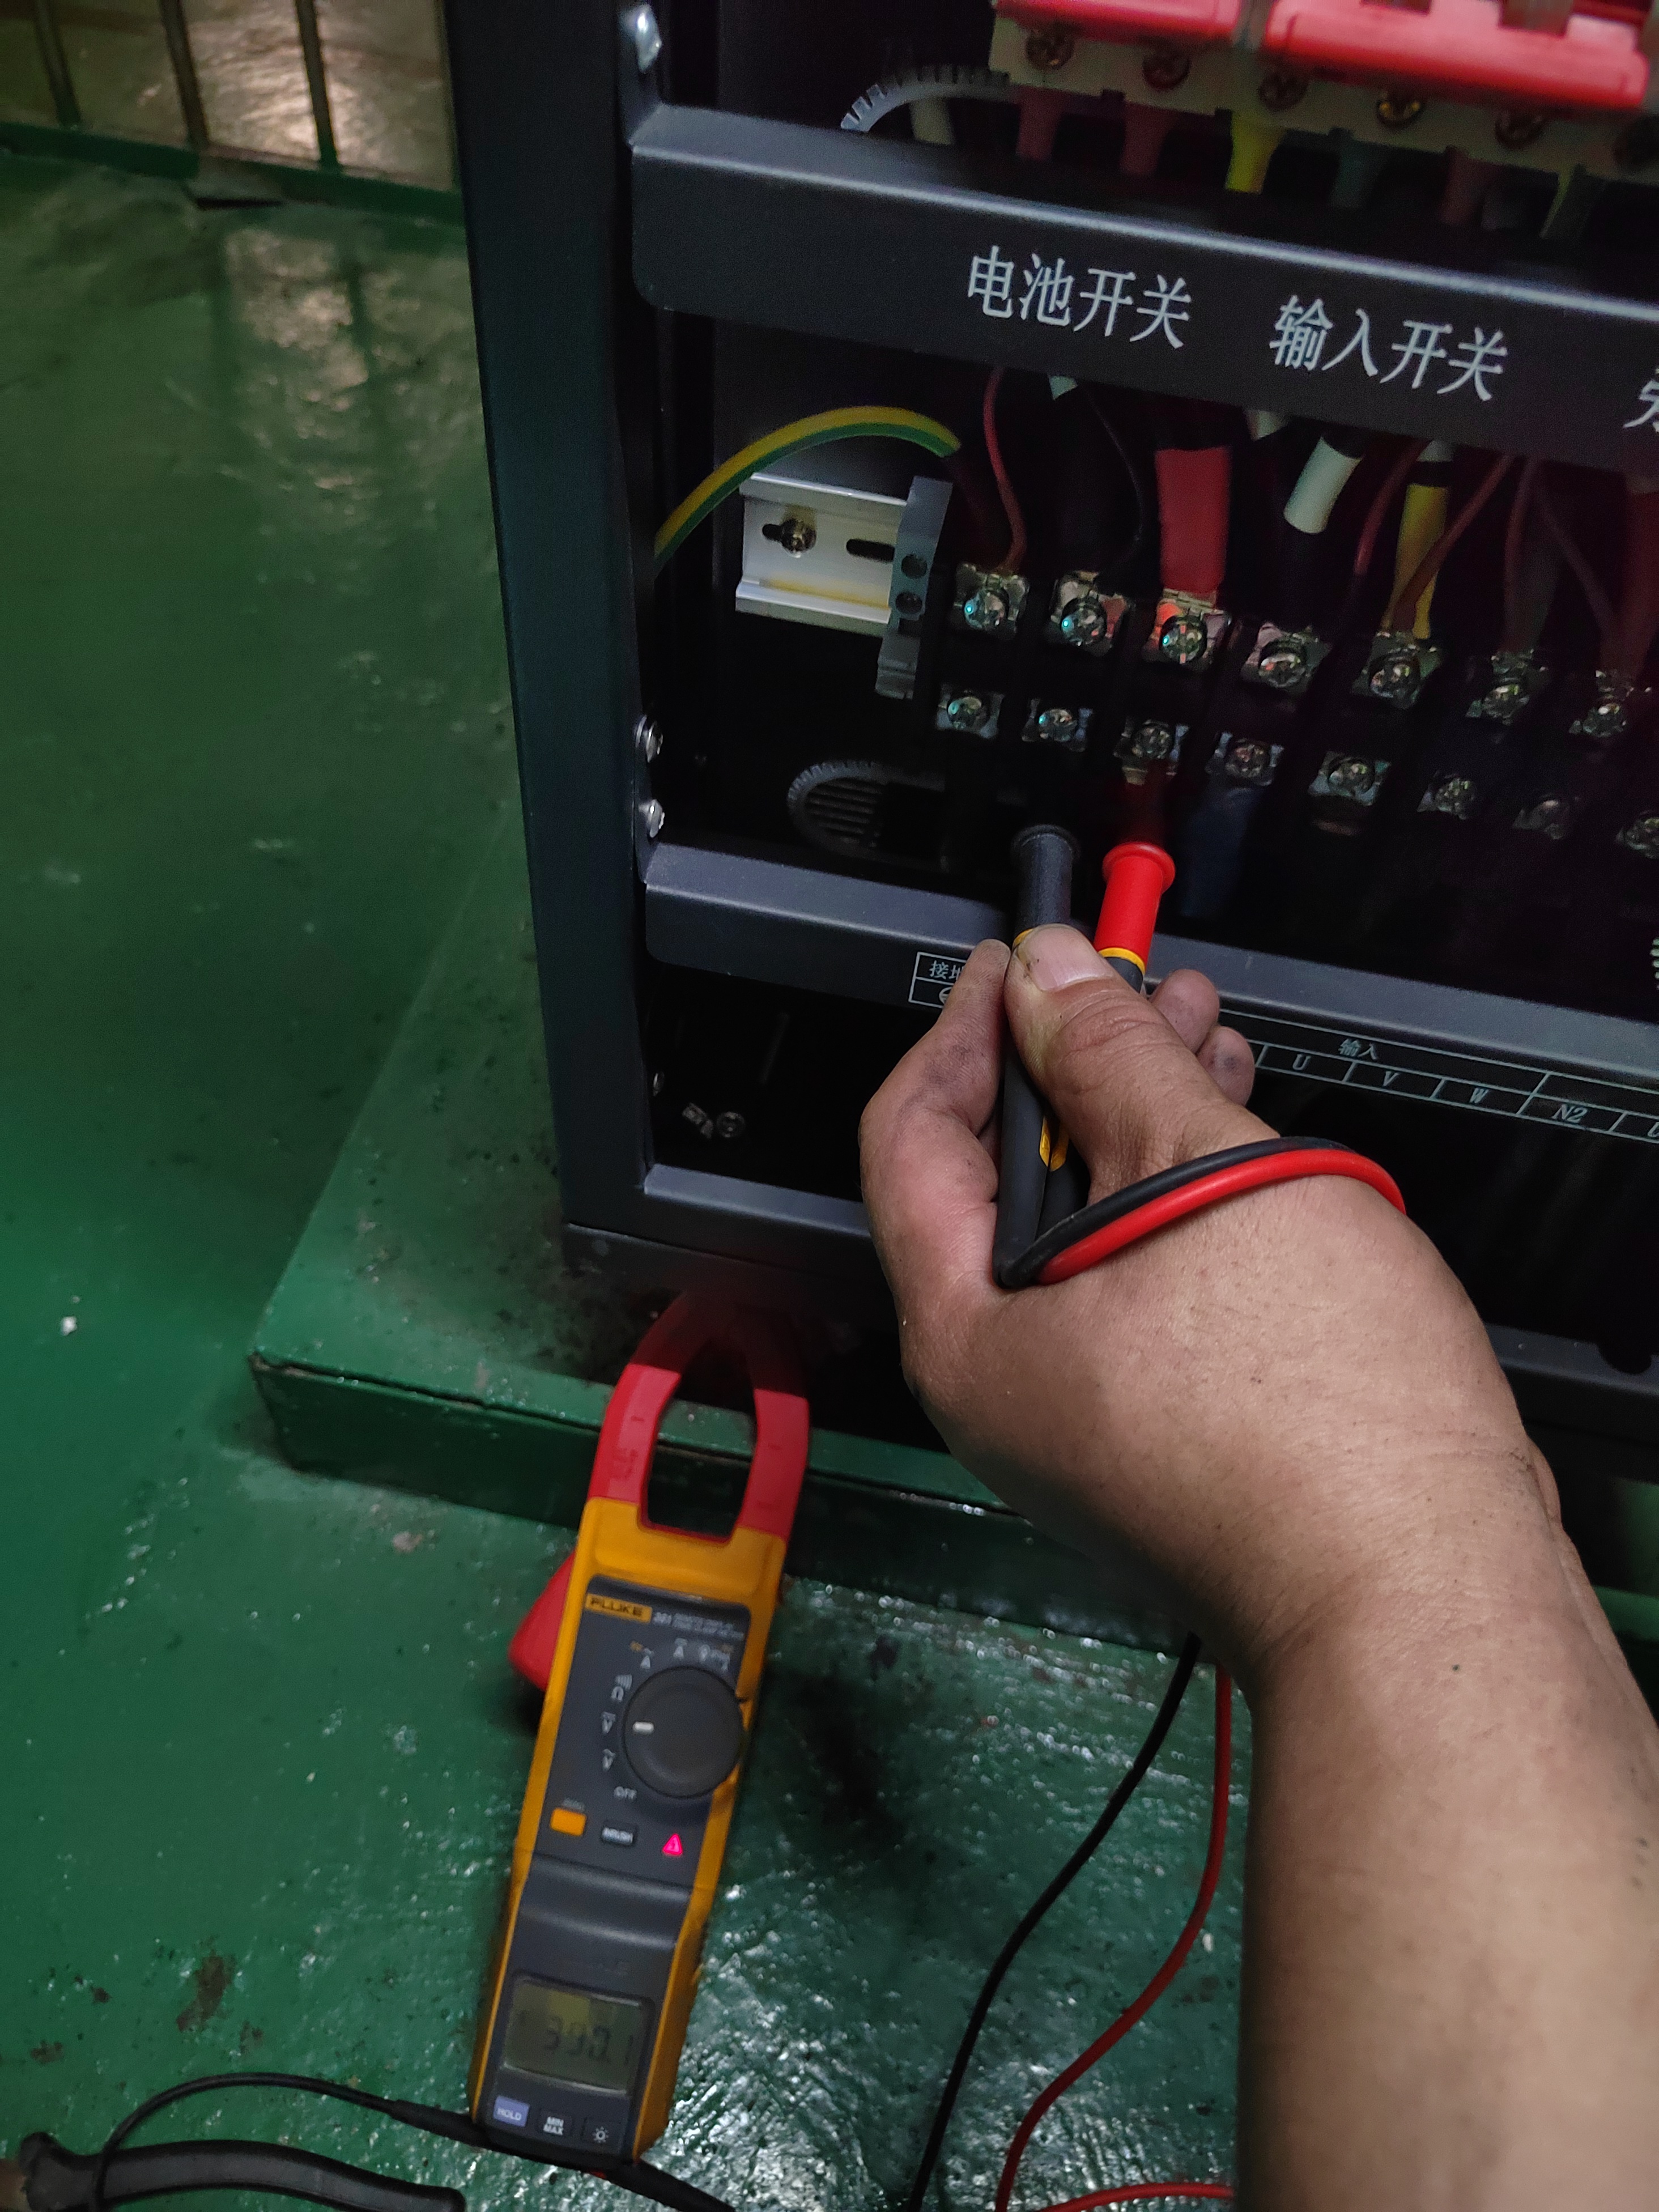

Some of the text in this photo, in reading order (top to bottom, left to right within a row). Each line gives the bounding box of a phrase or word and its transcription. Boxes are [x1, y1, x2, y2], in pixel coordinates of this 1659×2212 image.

[967, 245, 1192, 349] 电池开关
[1269, 295, 1508, 401] 输入开关
[1338, 1038, 1378, 1061] 输入
[1292, 1053, 1312, 1071] U
[1383, 1071, 1401, 1087] V
[1469, 1087, 1490, 1104] W
[1551, 1104, 1588, 1124] N2
[590, 1597, 643, 1618] FLUKE
[497, 2108, 522, 2121] HOLD
[546, 2116, 564, 2128] MIN
[543, 2124, 564, 2136] MAX
